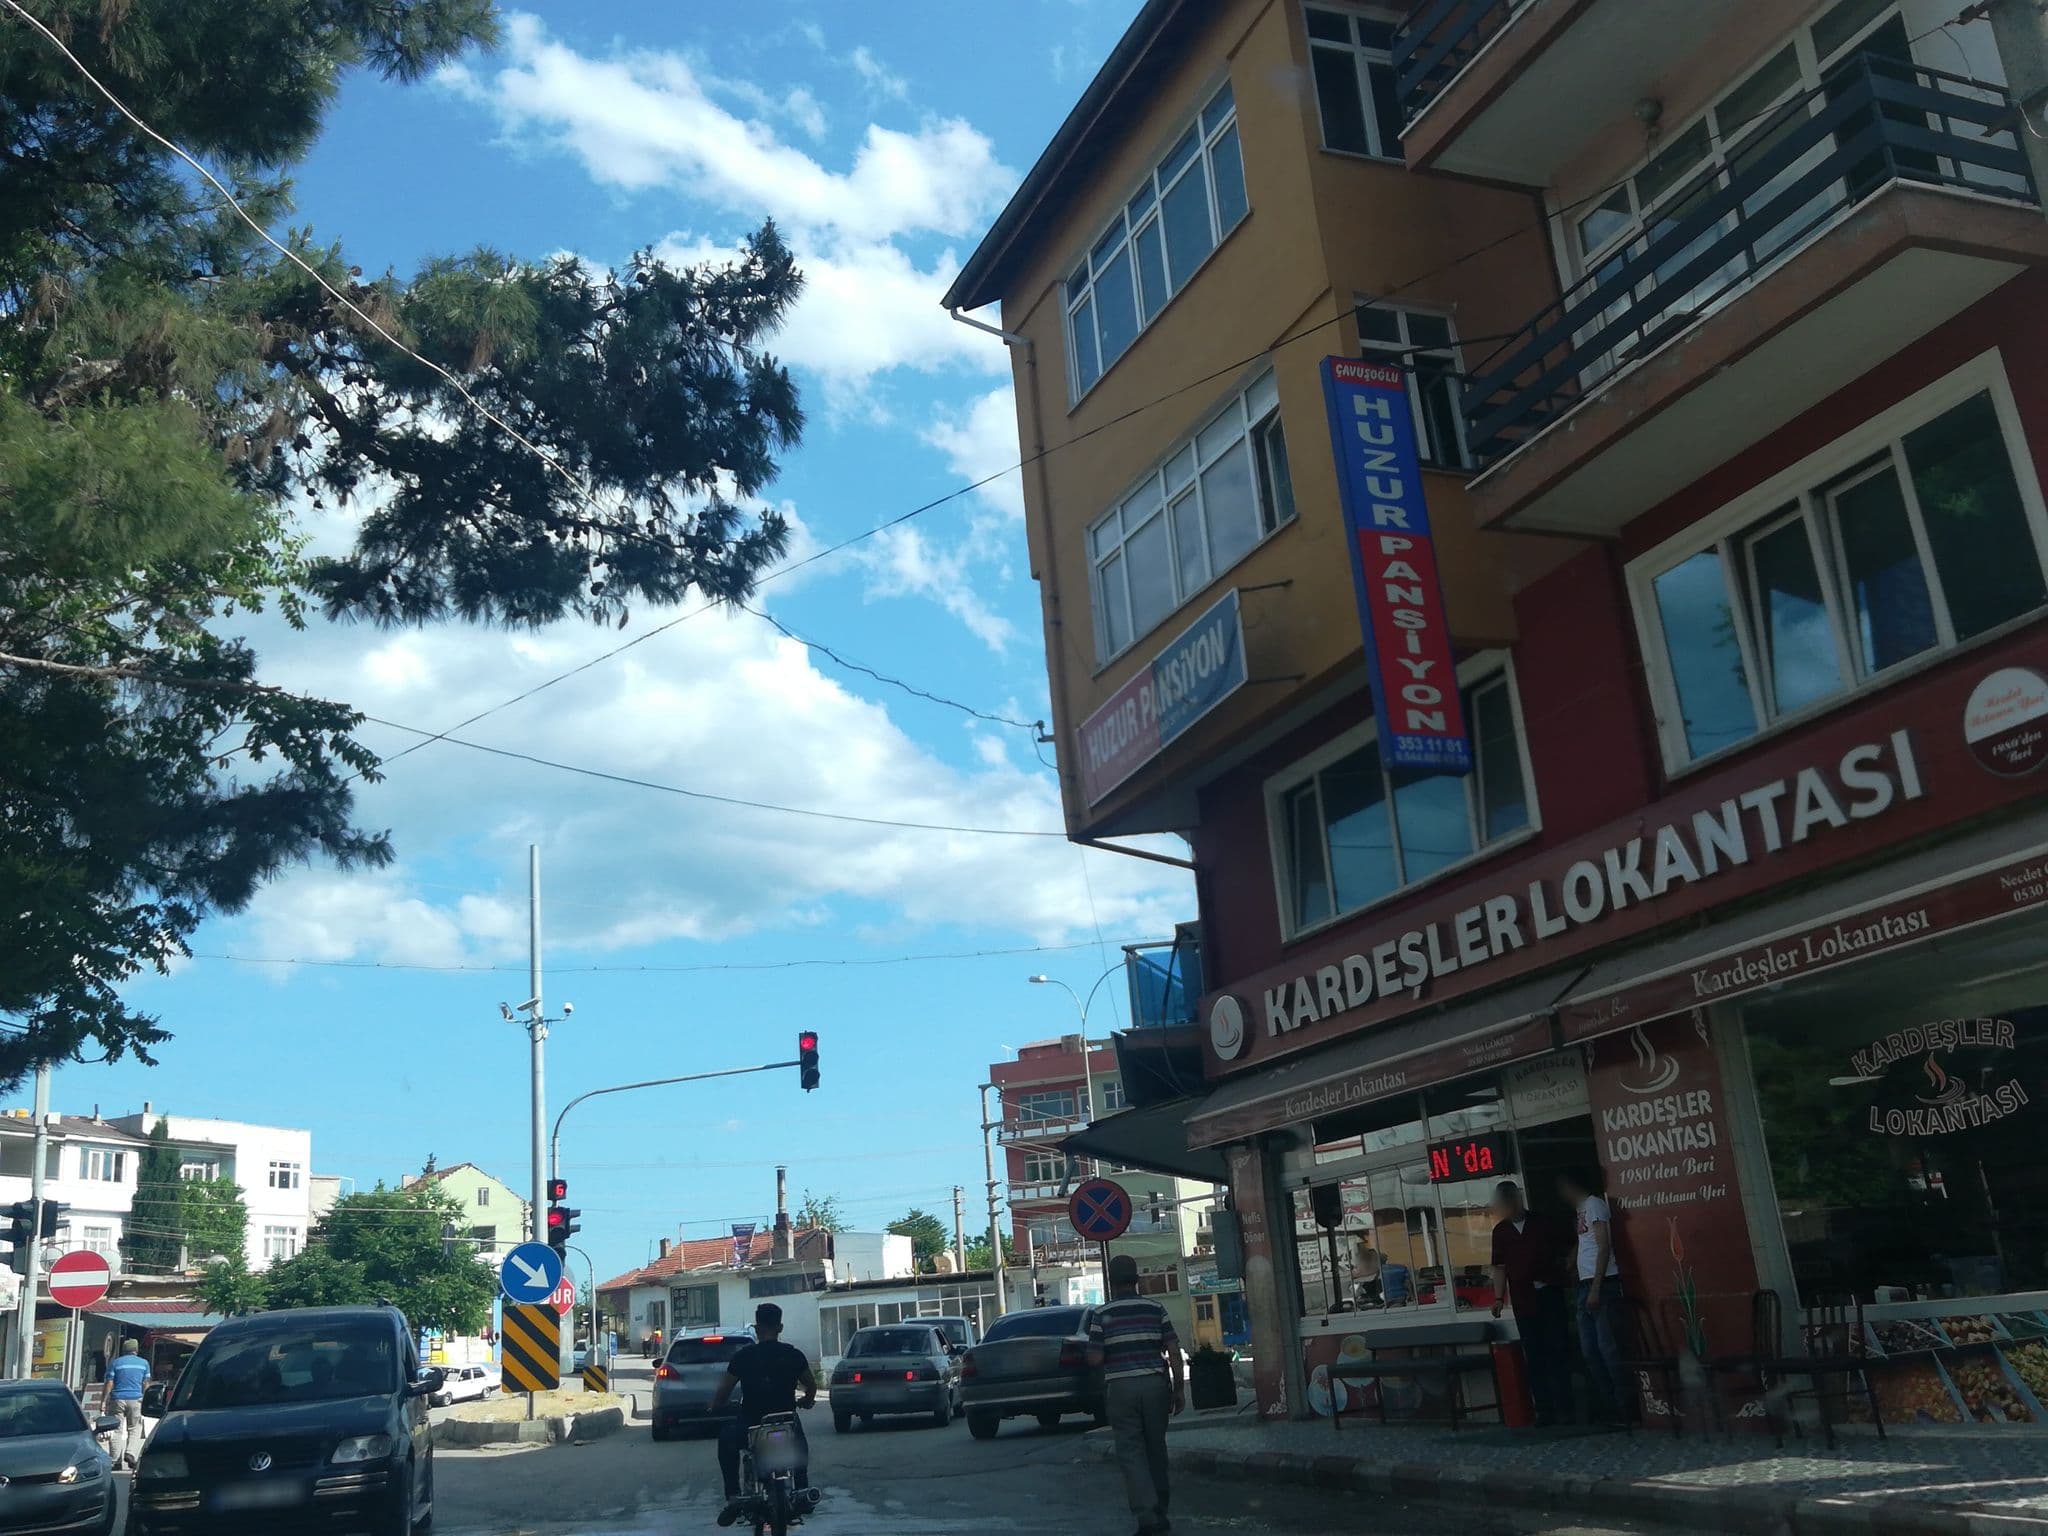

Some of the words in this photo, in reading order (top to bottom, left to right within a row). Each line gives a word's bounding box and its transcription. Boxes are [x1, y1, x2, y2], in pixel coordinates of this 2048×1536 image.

[1335, 364, 1399, 383] ÇAVUŞOĞLU
[1353, 393, 1410, 529] HUZUR
[1380, 536, 1446, 732] PANSİYON
[1087, 697, 1139, 773] HUZUR
[1263, 893, 1526, 1038] KARDEŞLER
[1528, 728, 1923, 940] LOKANTASI
[1999, 867, 2043, 889] Necdet
[2013, 883, 2044, 902] 0530
[1692, 947, 1799, 998] Kardeşler
[1801, 908, 1931, 964] Lokantası
[1851, 1017, 2015, 1078] KARDEŞLER
[1285, 1087, 1342, 1118] Kardeşler
[1343, 1071, 1408, 1103] Lokantası
[1602, 1089, 1713, 1133] KARDEŞLER
[1869, 1078, 2030, 1136] LOKANTASI
[1607, 1121, 1717, 1162] LOKANTASI
[555, 1184, 565, 1196] 6
[1619, 1162, 1679, 1185] 1980'den
[1682, 1154, 1716, 1175] Beri
[1699, 1183, 1726, 1200] Yeri
[549, 1288, 572, 1305] UR
